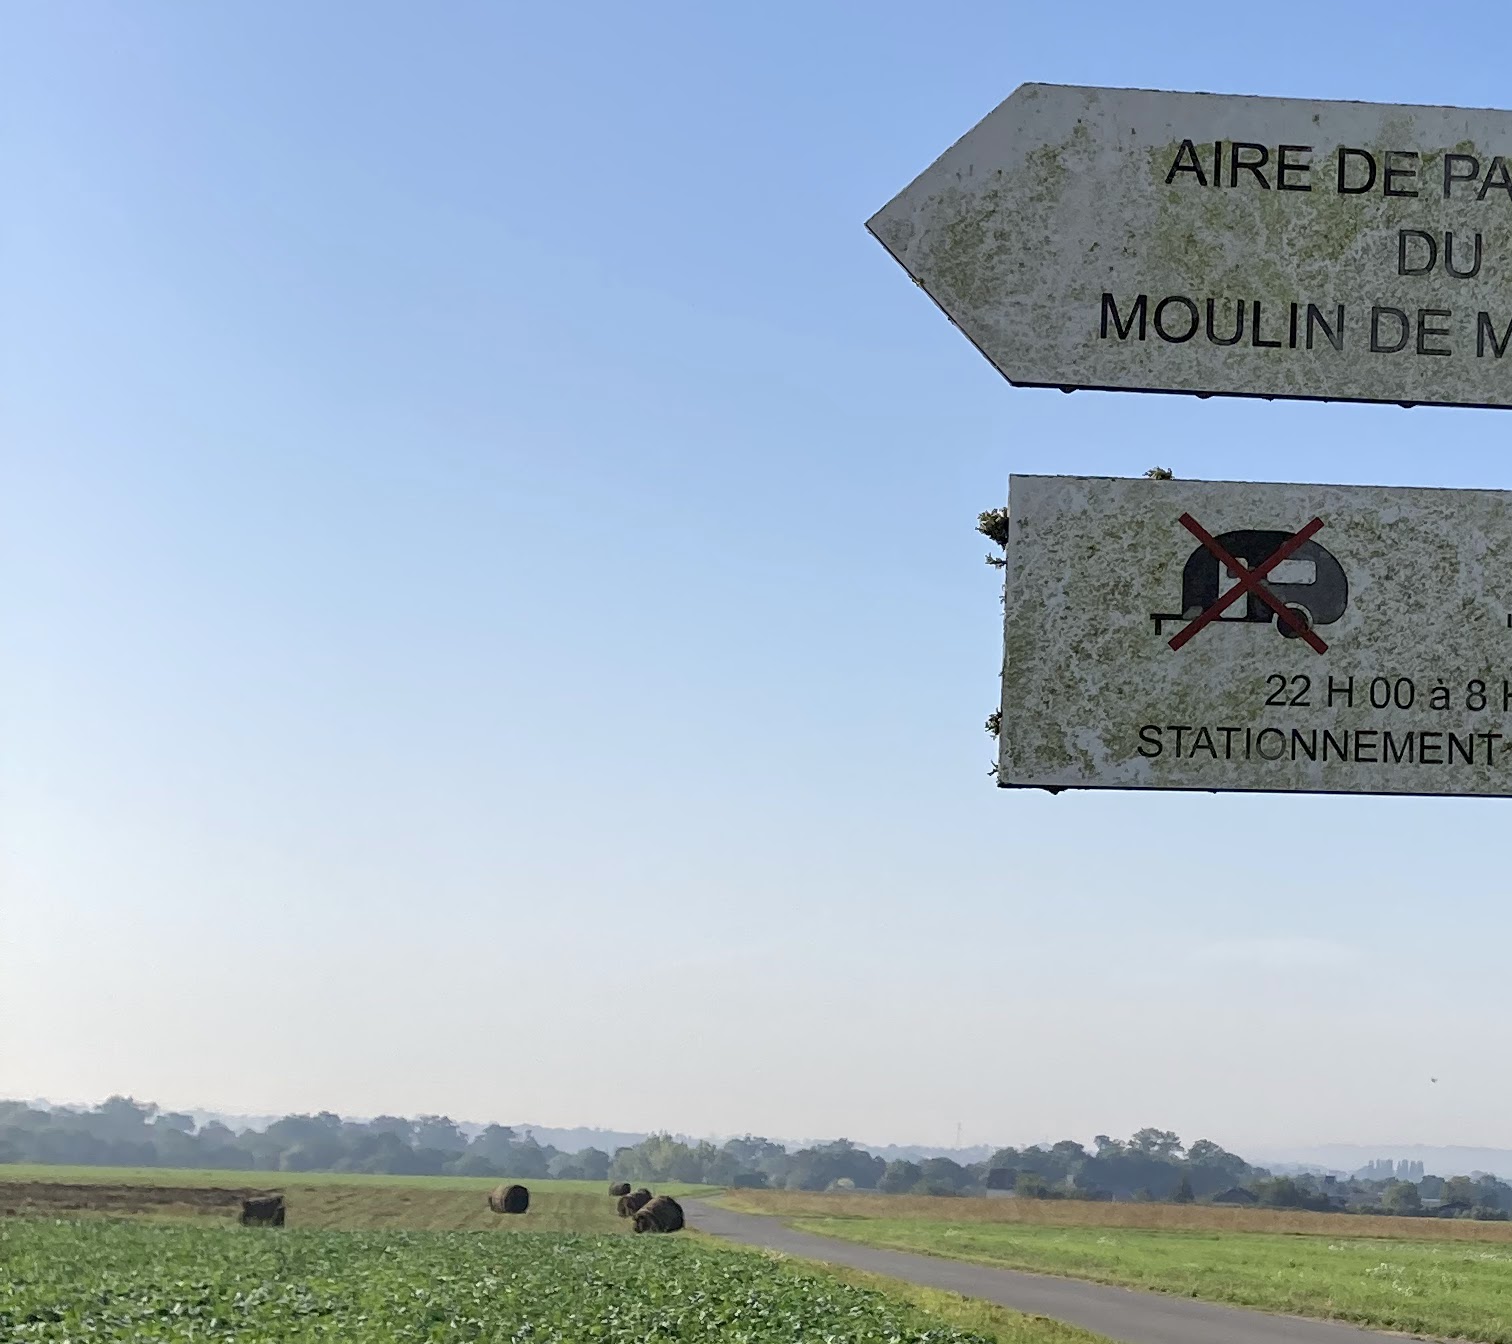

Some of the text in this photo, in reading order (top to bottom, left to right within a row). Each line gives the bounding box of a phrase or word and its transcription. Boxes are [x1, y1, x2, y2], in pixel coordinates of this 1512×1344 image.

[1165, 139, 1312, 192] AIRE
[1337, 148, 1419, 198] DE
[1398, 230, 1482, 279] DU
[1100, 292, 1345, 351] MOULIN
[1371, 306, 1452, 356] DE
[1265, 674, 1311, 707] 22
[1328, 675, 1354, 708] H
[1369, 676, 1415, 710] 00
[1429, 679, 1451, 712] à
[1466, 679, 1487, 712] 8
[1137, 725, 1502, 765] STATIONNEMENT
